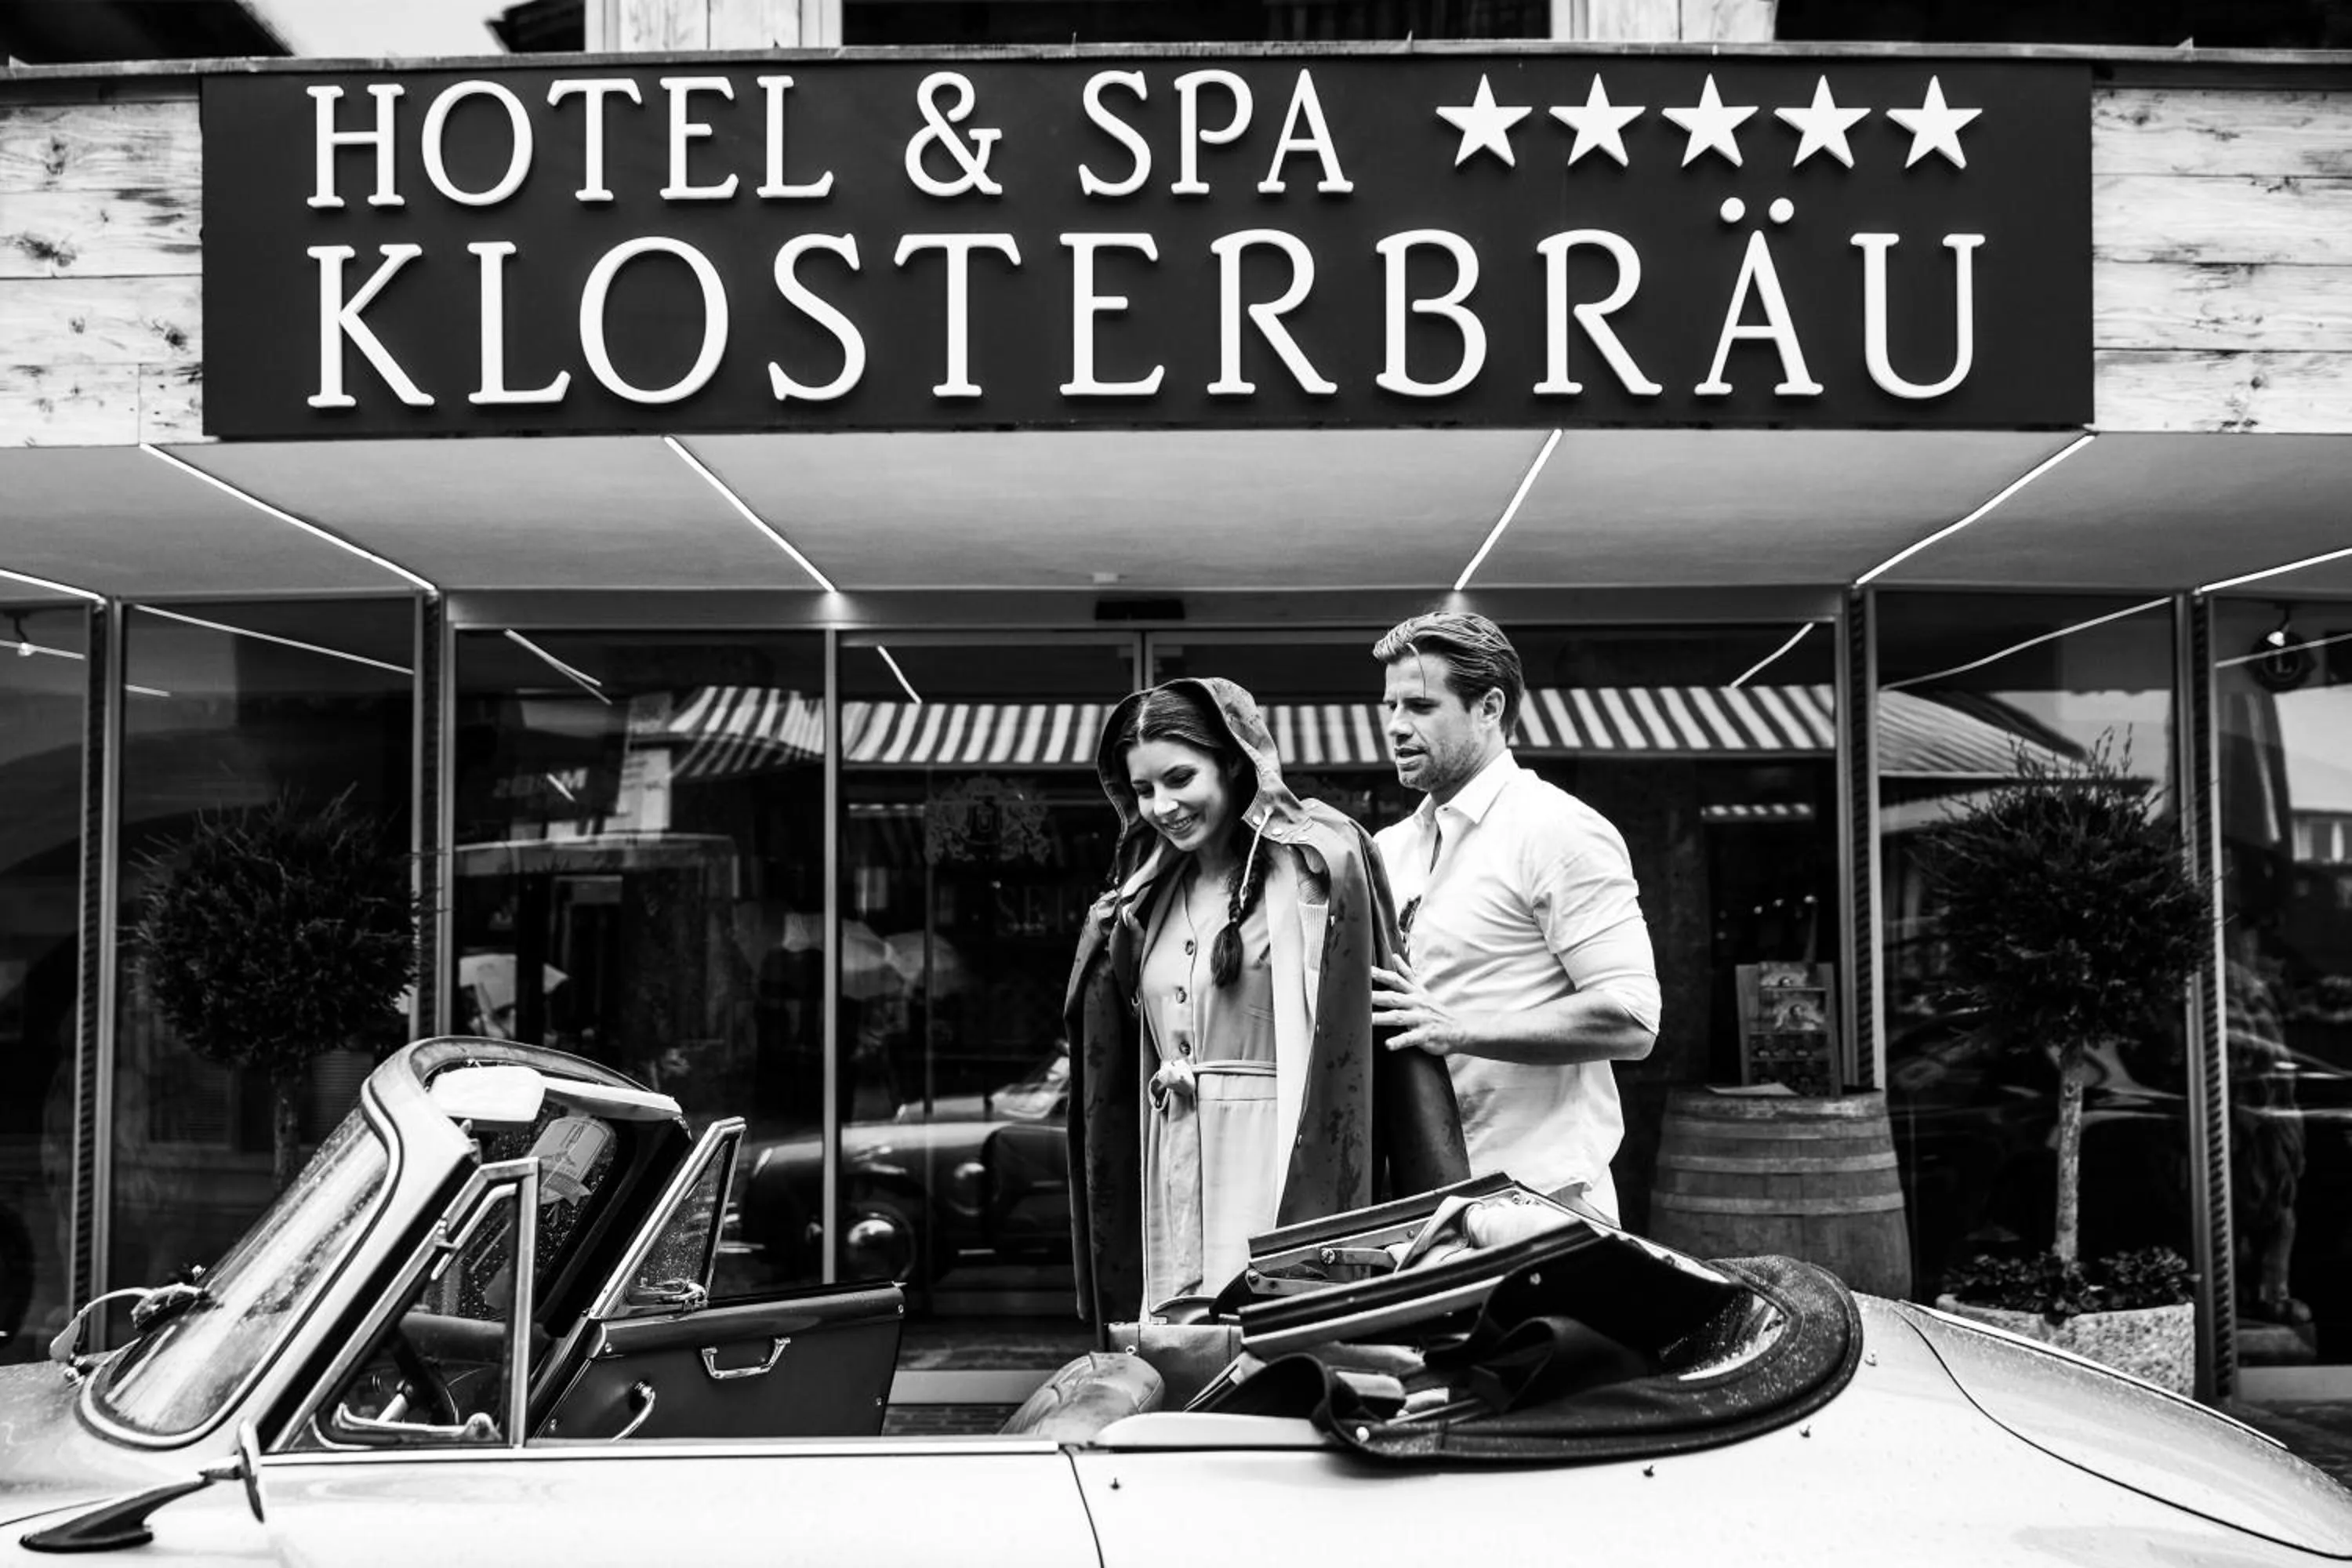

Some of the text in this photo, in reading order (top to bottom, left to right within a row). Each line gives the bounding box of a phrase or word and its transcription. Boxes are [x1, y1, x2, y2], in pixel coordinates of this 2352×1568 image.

[306, 68, 1355, 209] HOTEL & SPA
[307, 197, 1987, 408] KLOSTERBRÄU
